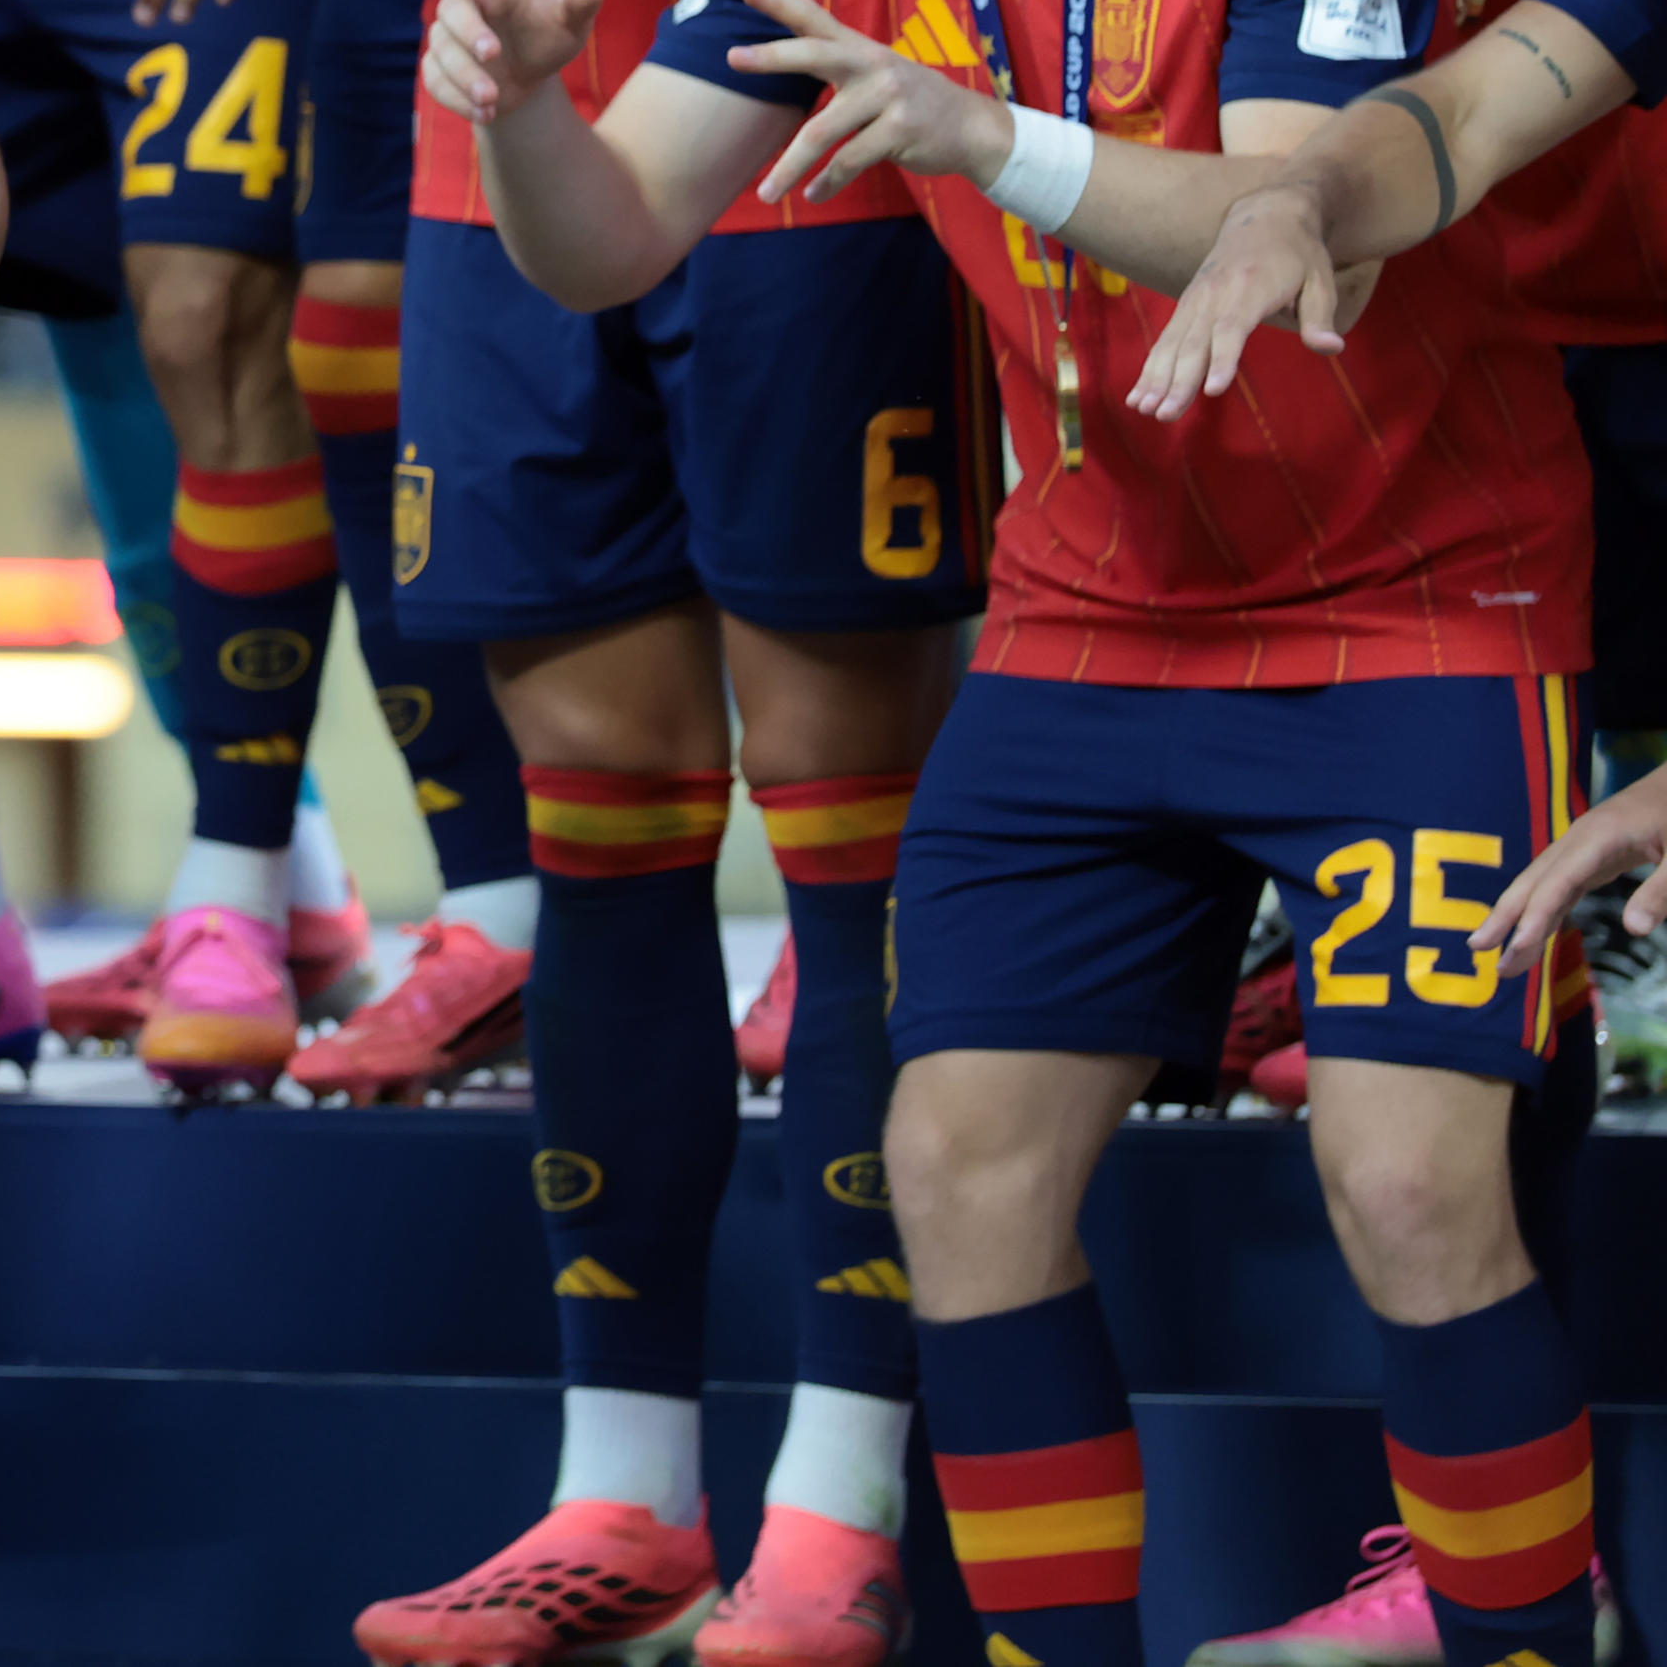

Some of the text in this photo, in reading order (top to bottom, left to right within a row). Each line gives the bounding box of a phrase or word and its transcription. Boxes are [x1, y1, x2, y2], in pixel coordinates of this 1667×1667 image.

[121, 35, 288, 201] 24
[1066, 35, 1083, 91] CUP
[861, 406, 942, 580] 6
[1310, 828, 1504, 1009] 25
